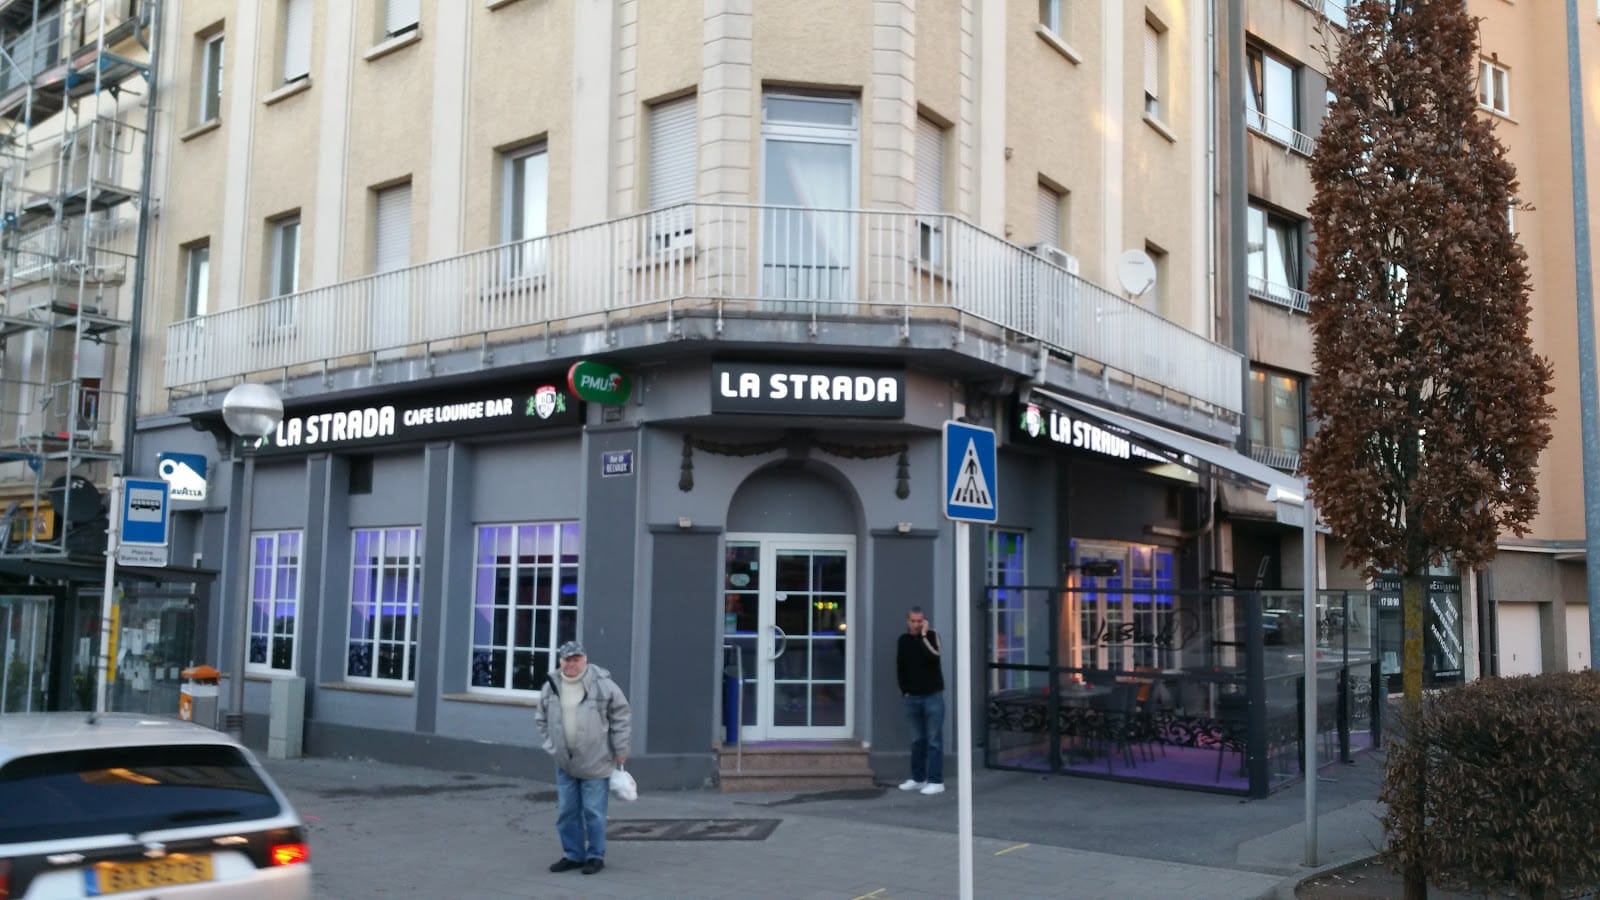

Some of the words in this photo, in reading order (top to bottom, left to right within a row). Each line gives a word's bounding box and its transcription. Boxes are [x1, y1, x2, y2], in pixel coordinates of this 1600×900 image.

[580, 374, 609, 391] PMU
[720, 371, 760, 398] LA
[769, 373, 898, 402] STRADA
[276, 417, 302, 448] LA
[305, 405, 395, 444] STRADA
[403, 407, 434, 426] CAFE
[434, 401, 484, 423] LOUNGE
[484, 398, 513, 417] BAR
[1050, 412, 1071, 444] LA
[1072, 419, 1131, 460] STRADA
[171, 487, 203, 497] AVAZZA
